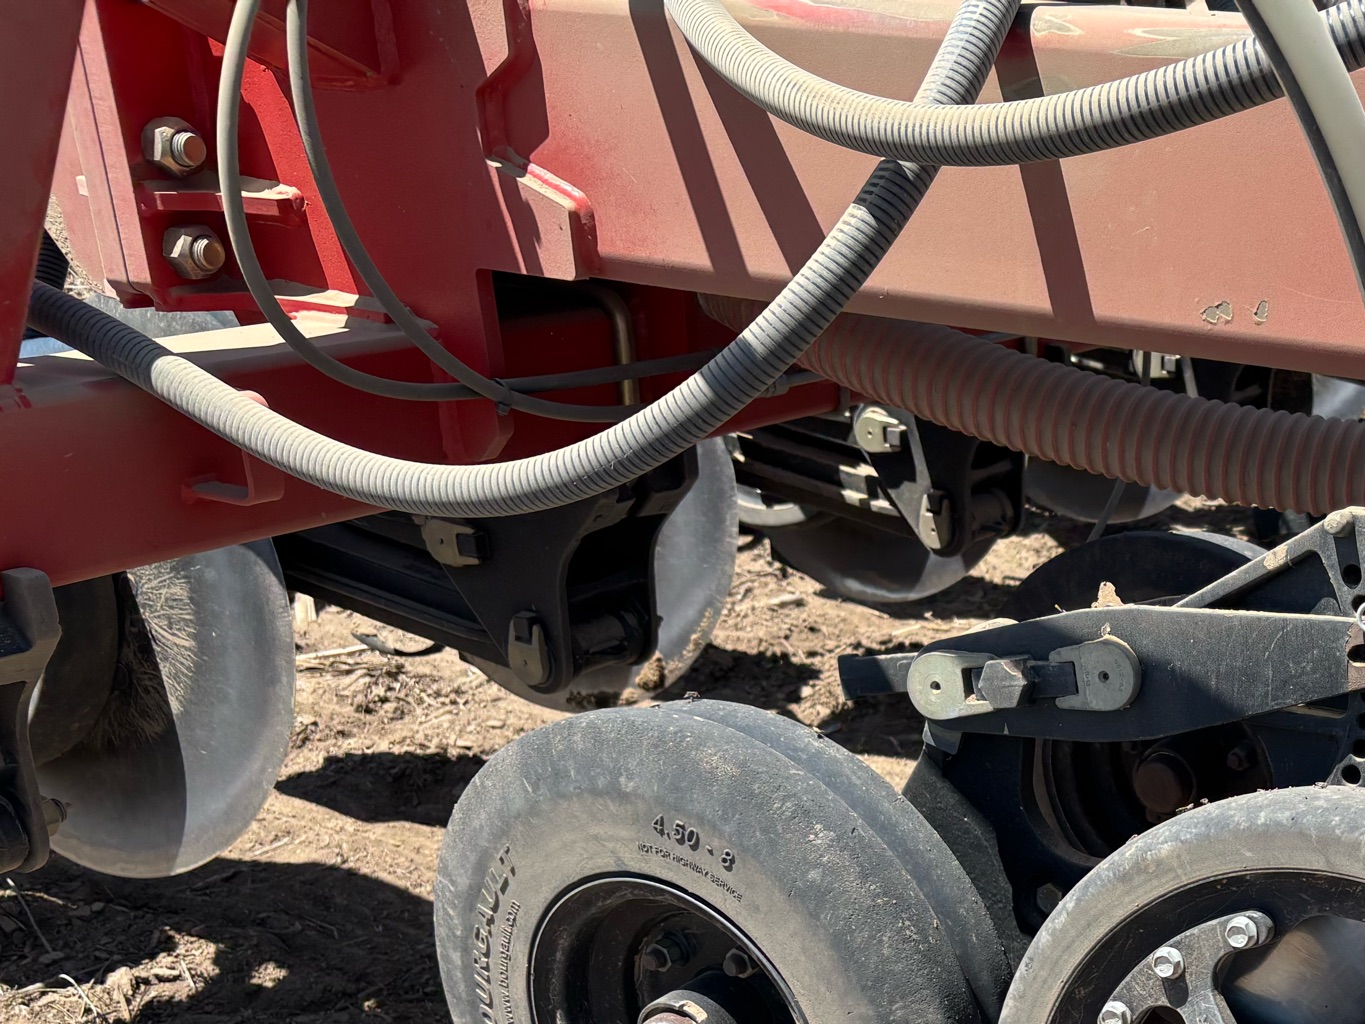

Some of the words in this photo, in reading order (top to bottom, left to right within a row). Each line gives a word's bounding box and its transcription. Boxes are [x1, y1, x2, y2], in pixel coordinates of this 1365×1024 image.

[636, 842, 654, 854] NOT
[655, 845, 671, 860] FOR
[672, 853, 709, 878] HIGHWAY
[709, 873, 743, 903] SERVICE
[652, 814, 700, 851] 4.50
[721, 849, 736, 872] 8
[499, 900, 521, 1024] www.bourgault.com
